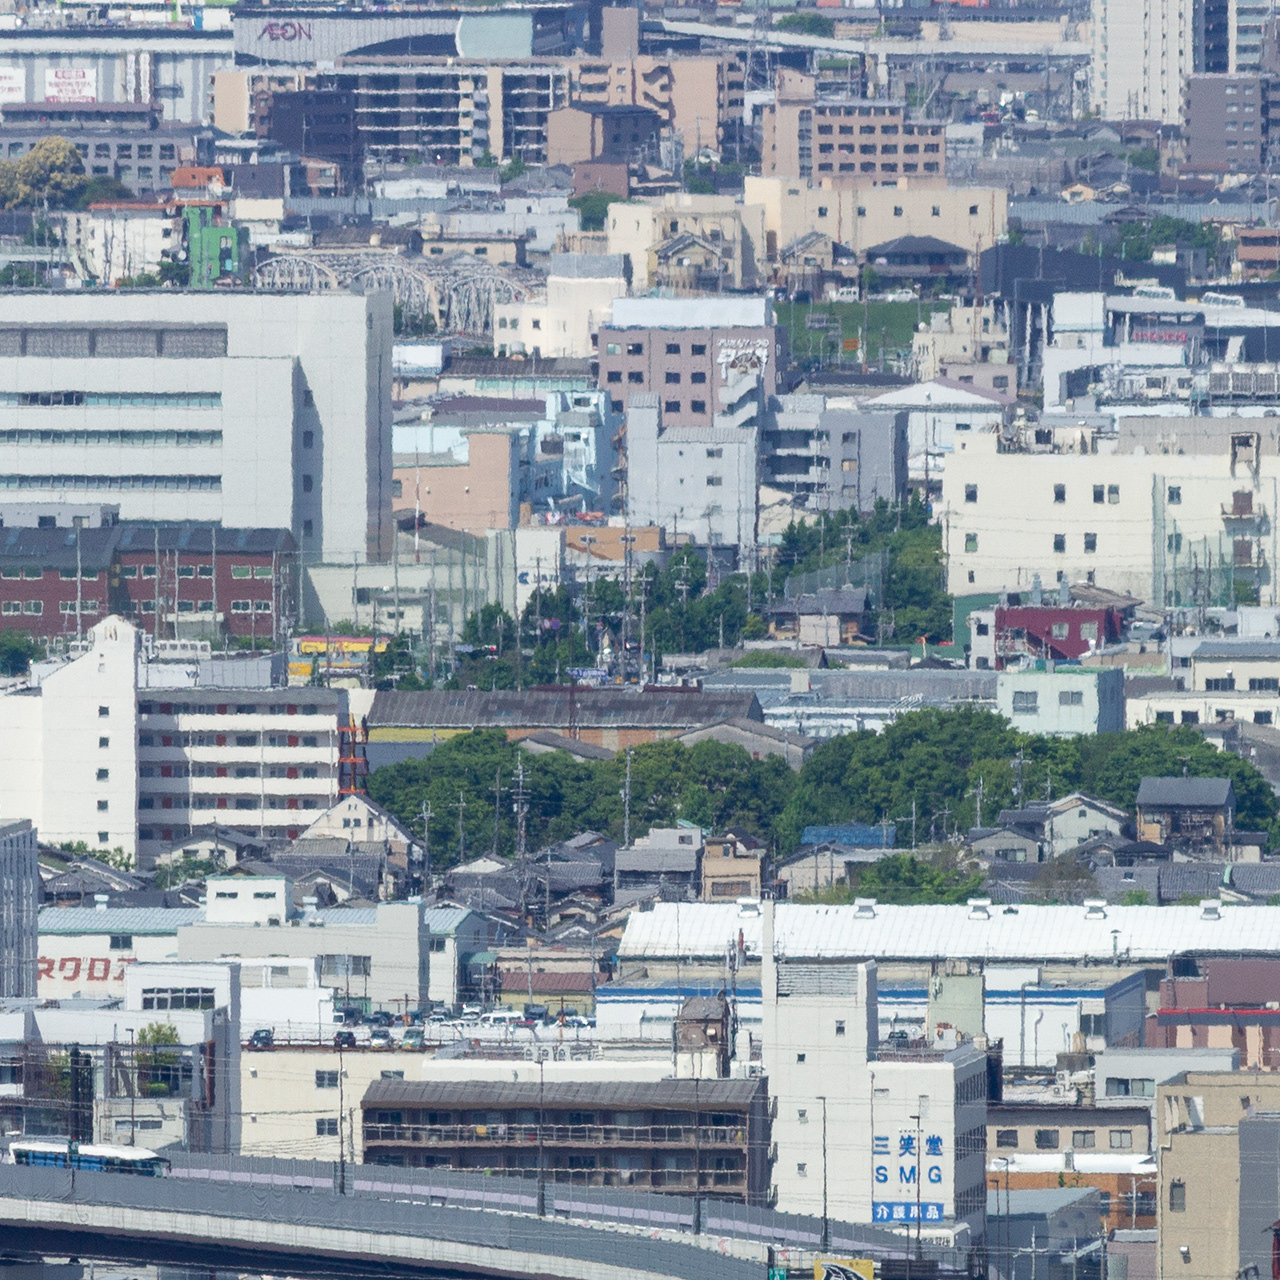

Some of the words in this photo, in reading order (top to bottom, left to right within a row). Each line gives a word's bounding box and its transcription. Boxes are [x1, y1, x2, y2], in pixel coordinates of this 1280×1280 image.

[872, 1135, 943, 1157] 三笑堂
[876, 1205, 939, 1219] 介護用品
